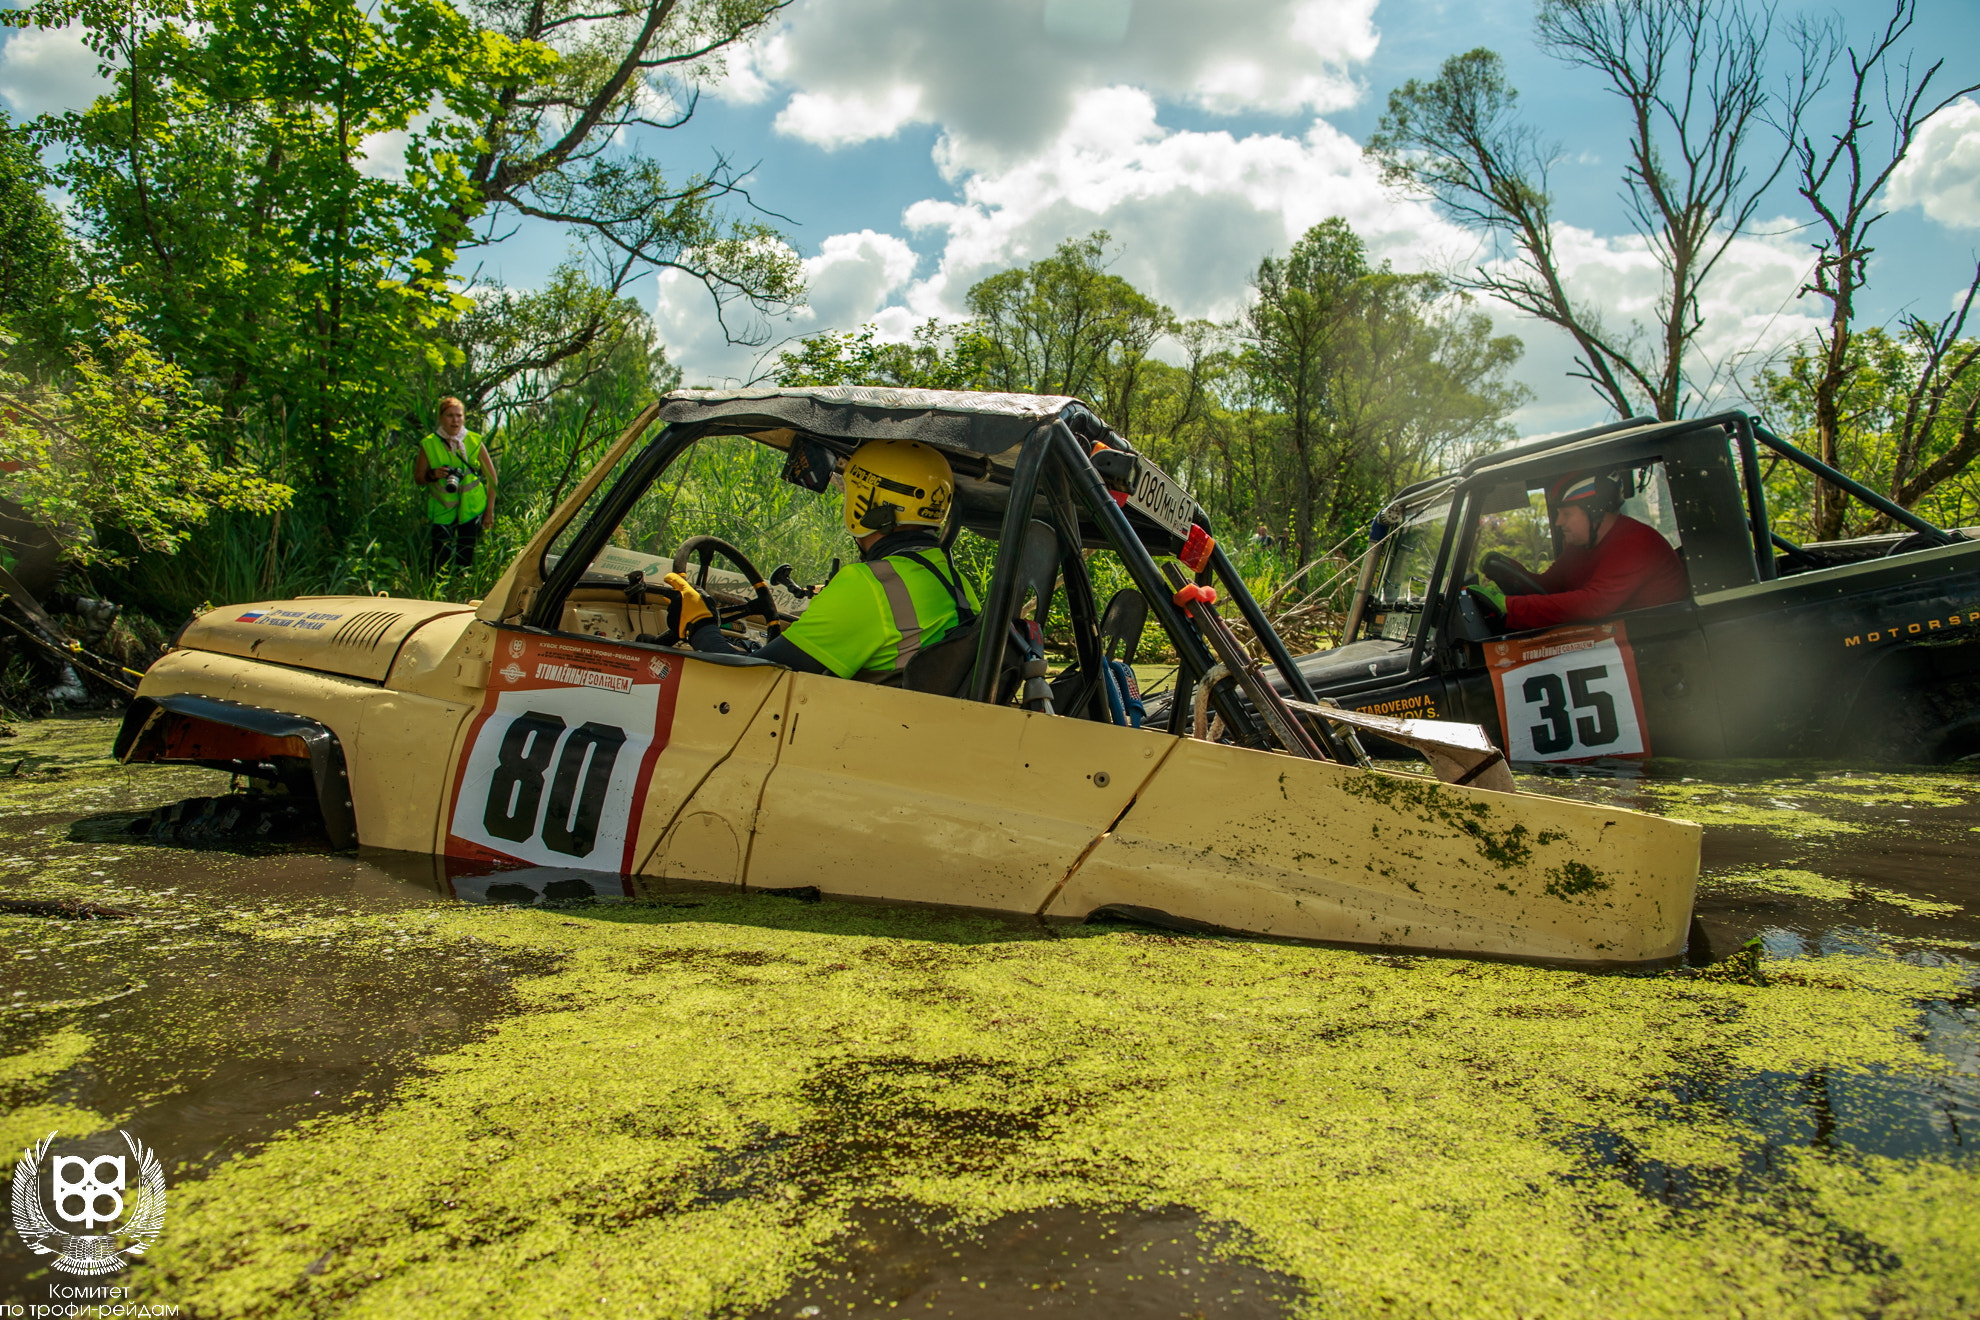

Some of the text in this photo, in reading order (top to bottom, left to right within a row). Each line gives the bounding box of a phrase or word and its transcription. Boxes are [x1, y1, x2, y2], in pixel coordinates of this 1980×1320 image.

[1424, 694, 1435, 706] A.
[1426, 707, 1440, 719] S.
[1522, 665, 1620, 755] 35
[483, 710, 628, 859] 80
